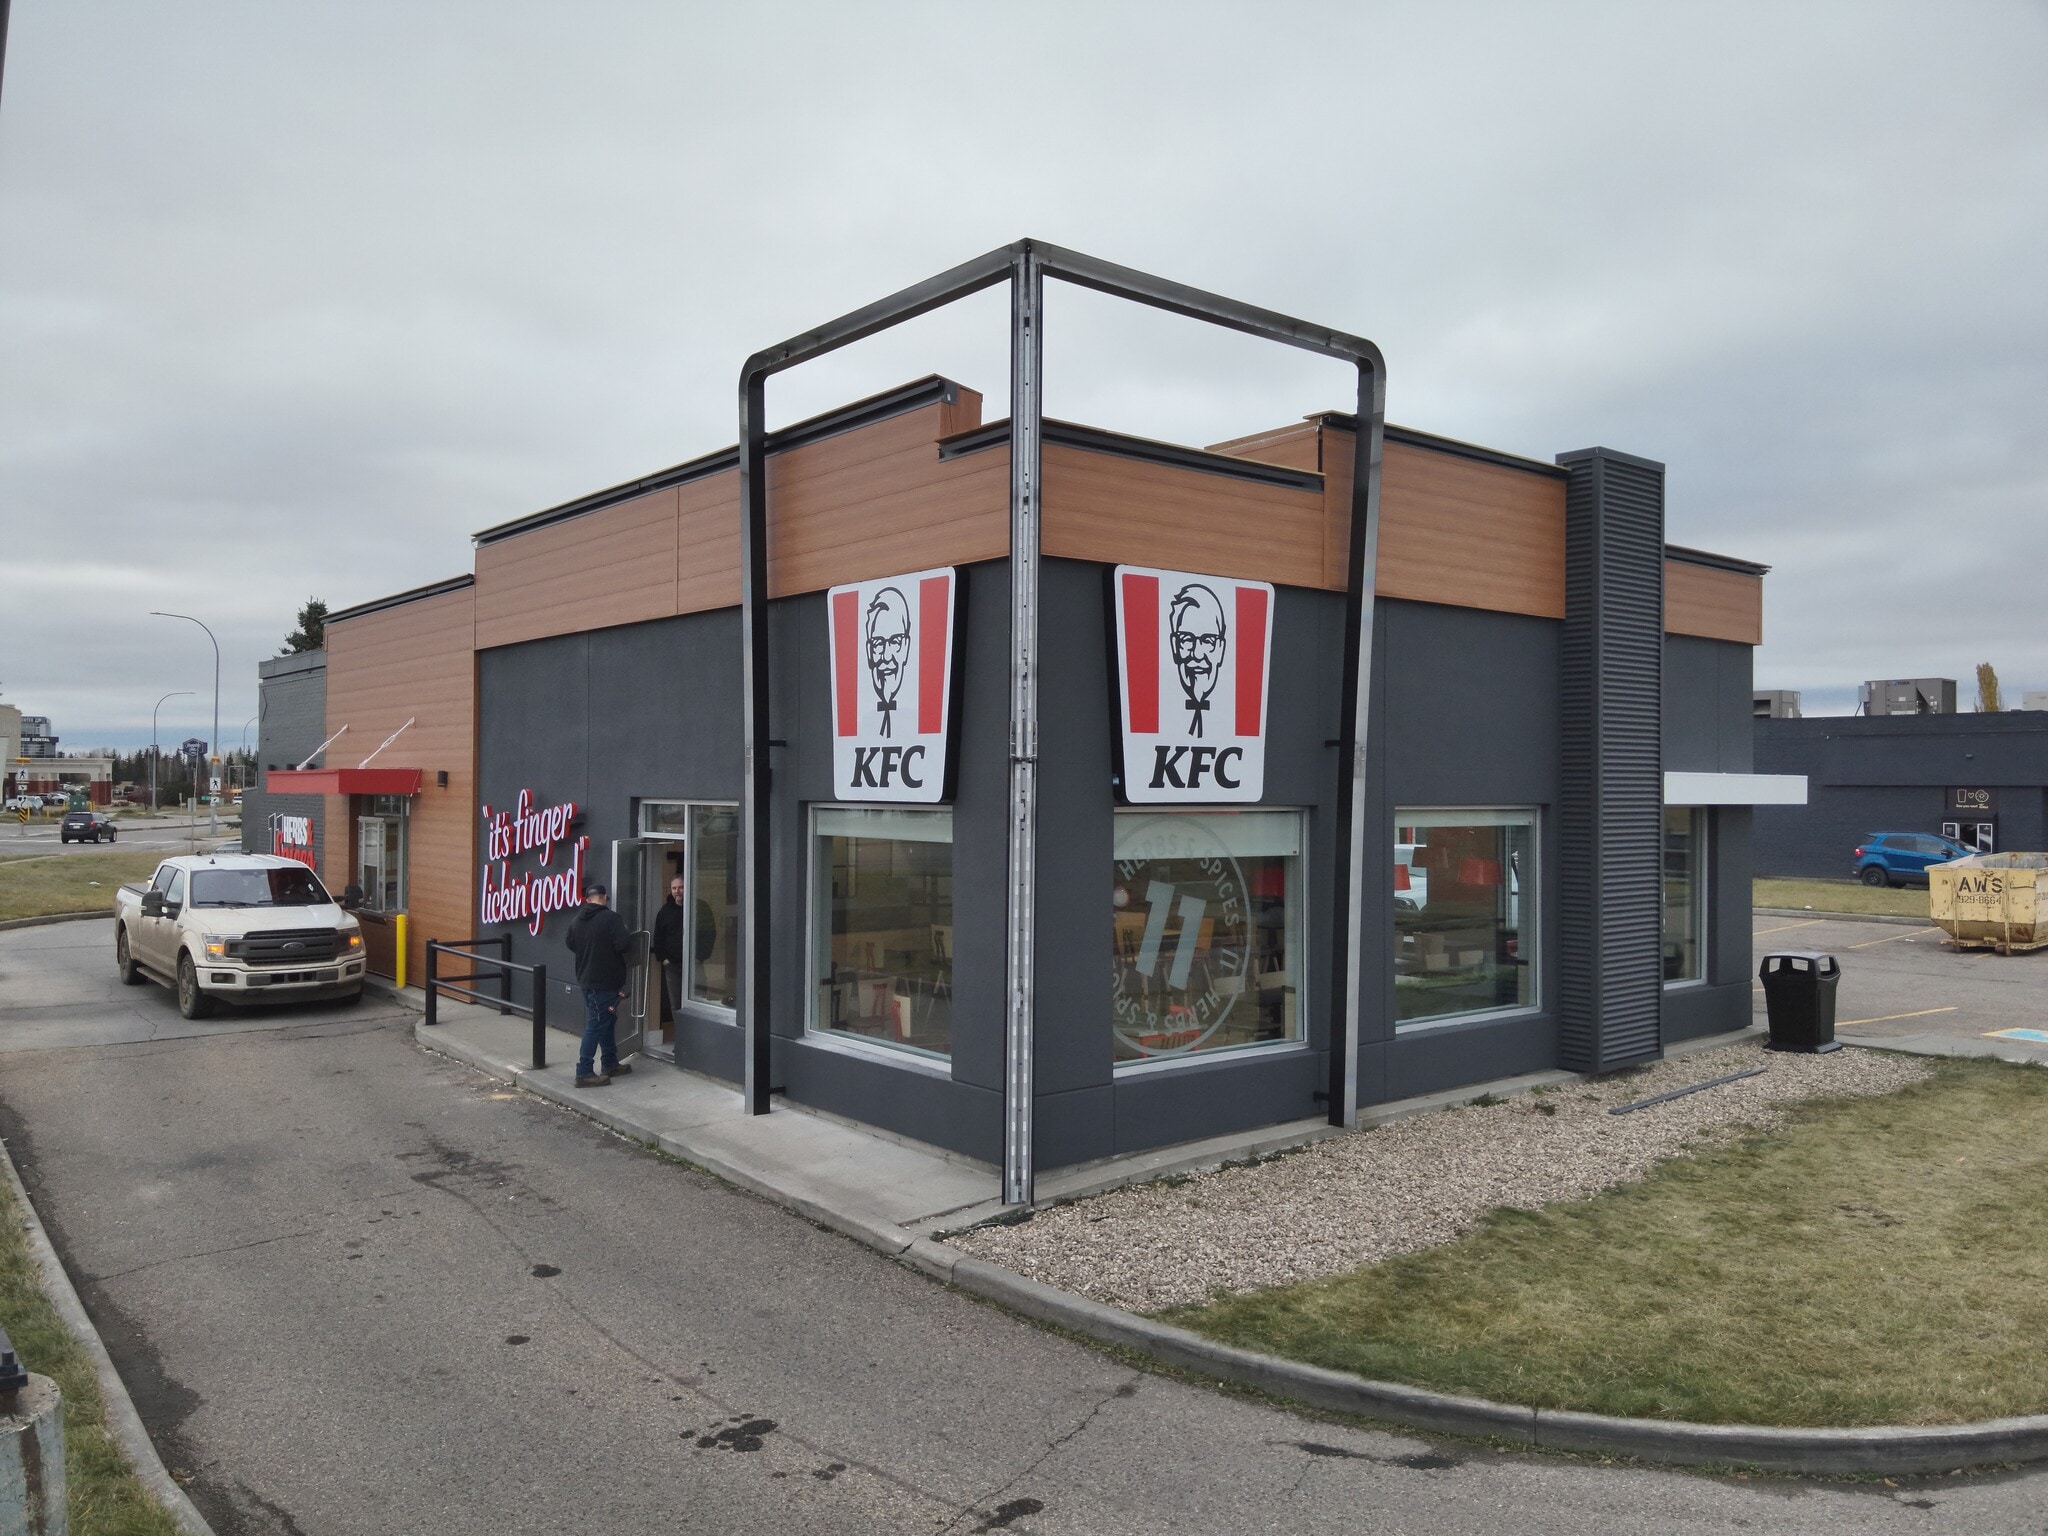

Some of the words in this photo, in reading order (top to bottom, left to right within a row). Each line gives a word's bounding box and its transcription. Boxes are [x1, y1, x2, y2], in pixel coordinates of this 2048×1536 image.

[851, 745, 925, 789] KFC
[1148, 745, 1244, 789] KFC
[283, 816, 308, 845] HERBS
[307, 817, 314, 846] &
[513, 788, 578, 867] finger
[1200, 857, 1240, 928] SPICES
[1135, 879, 1208, 991] 11
